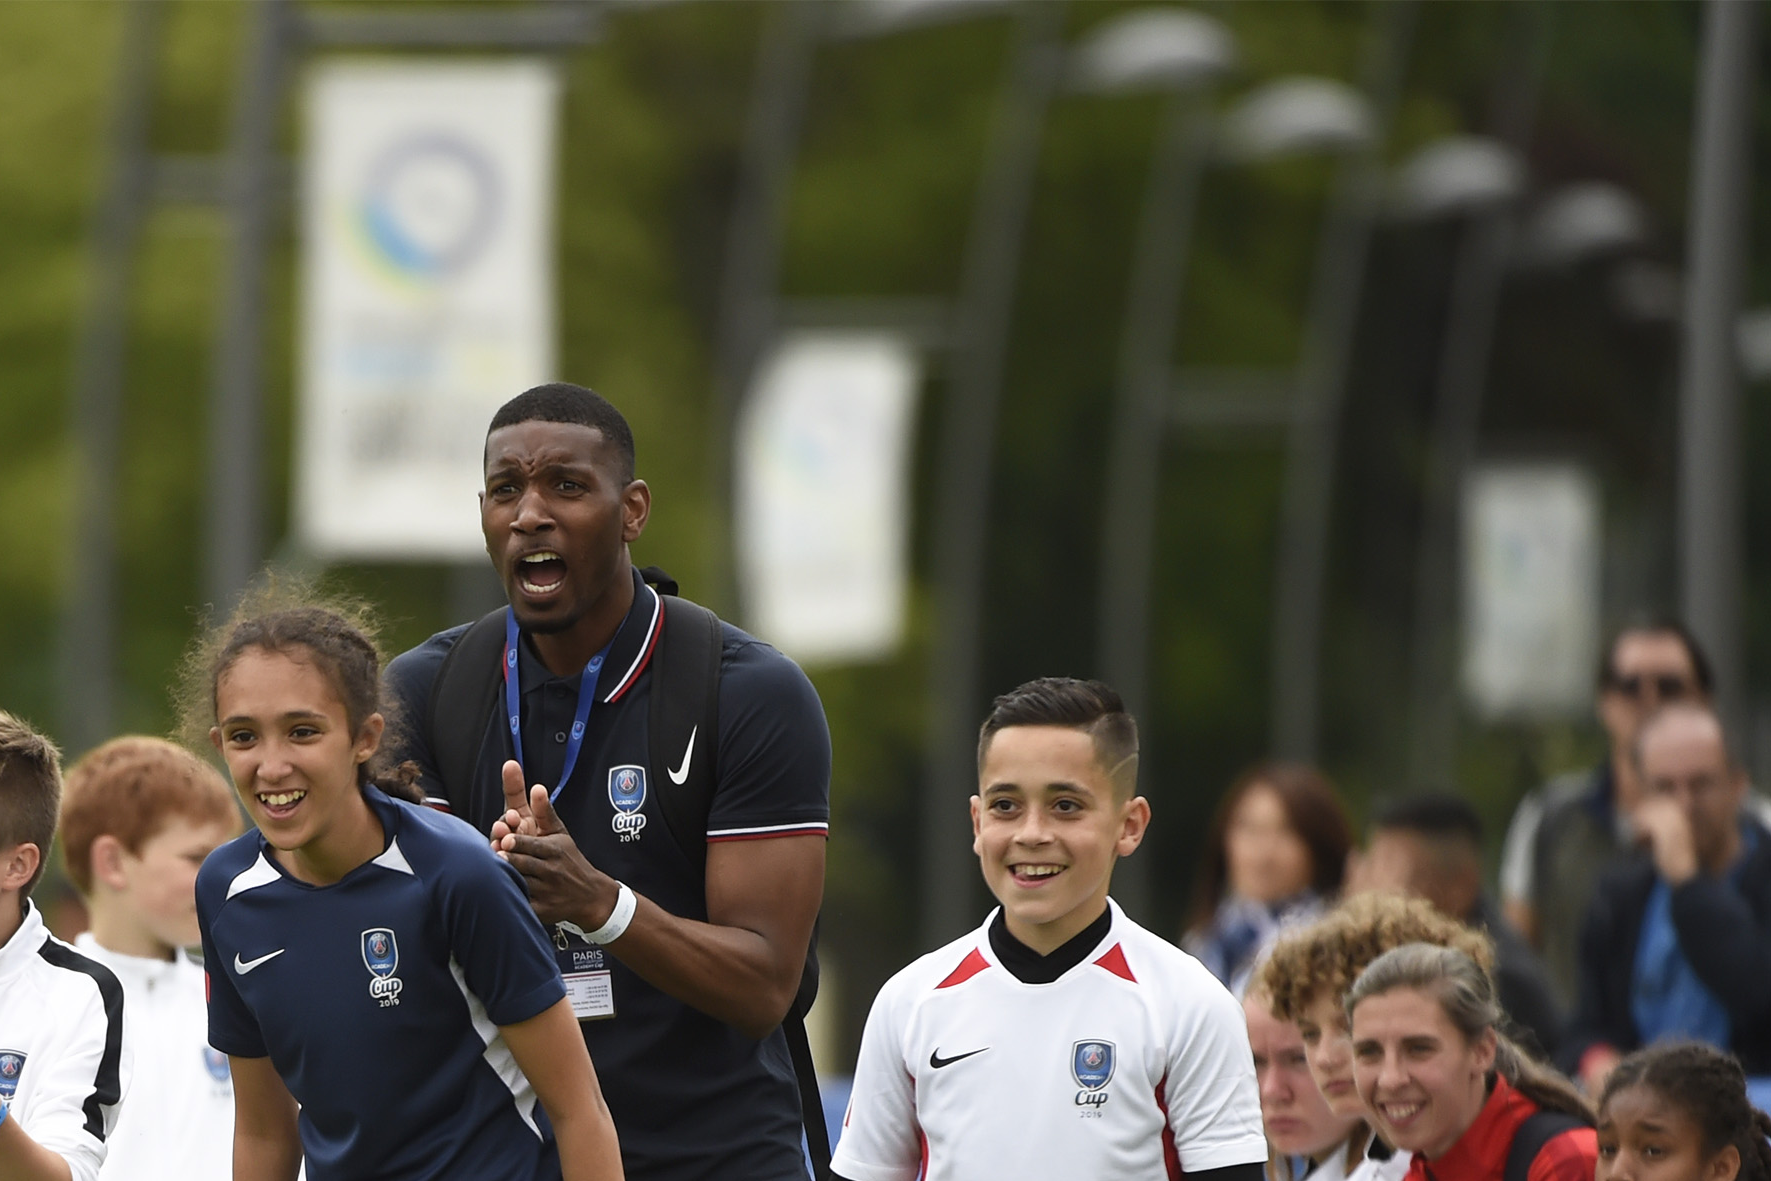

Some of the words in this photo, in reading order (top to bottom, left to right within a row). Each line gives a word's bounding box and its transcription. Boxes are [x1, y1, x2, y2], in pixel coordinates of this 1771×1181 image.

[612, 812, 647, 835] Cup
[619, 833, 641, 843] 2019
[572, 949, 603, 962] PARIS
[369, 977, 403, 998] Cup
[379, 998, 401, 1008] 2019
[1074, 1089, 1109, 1109] Cup
